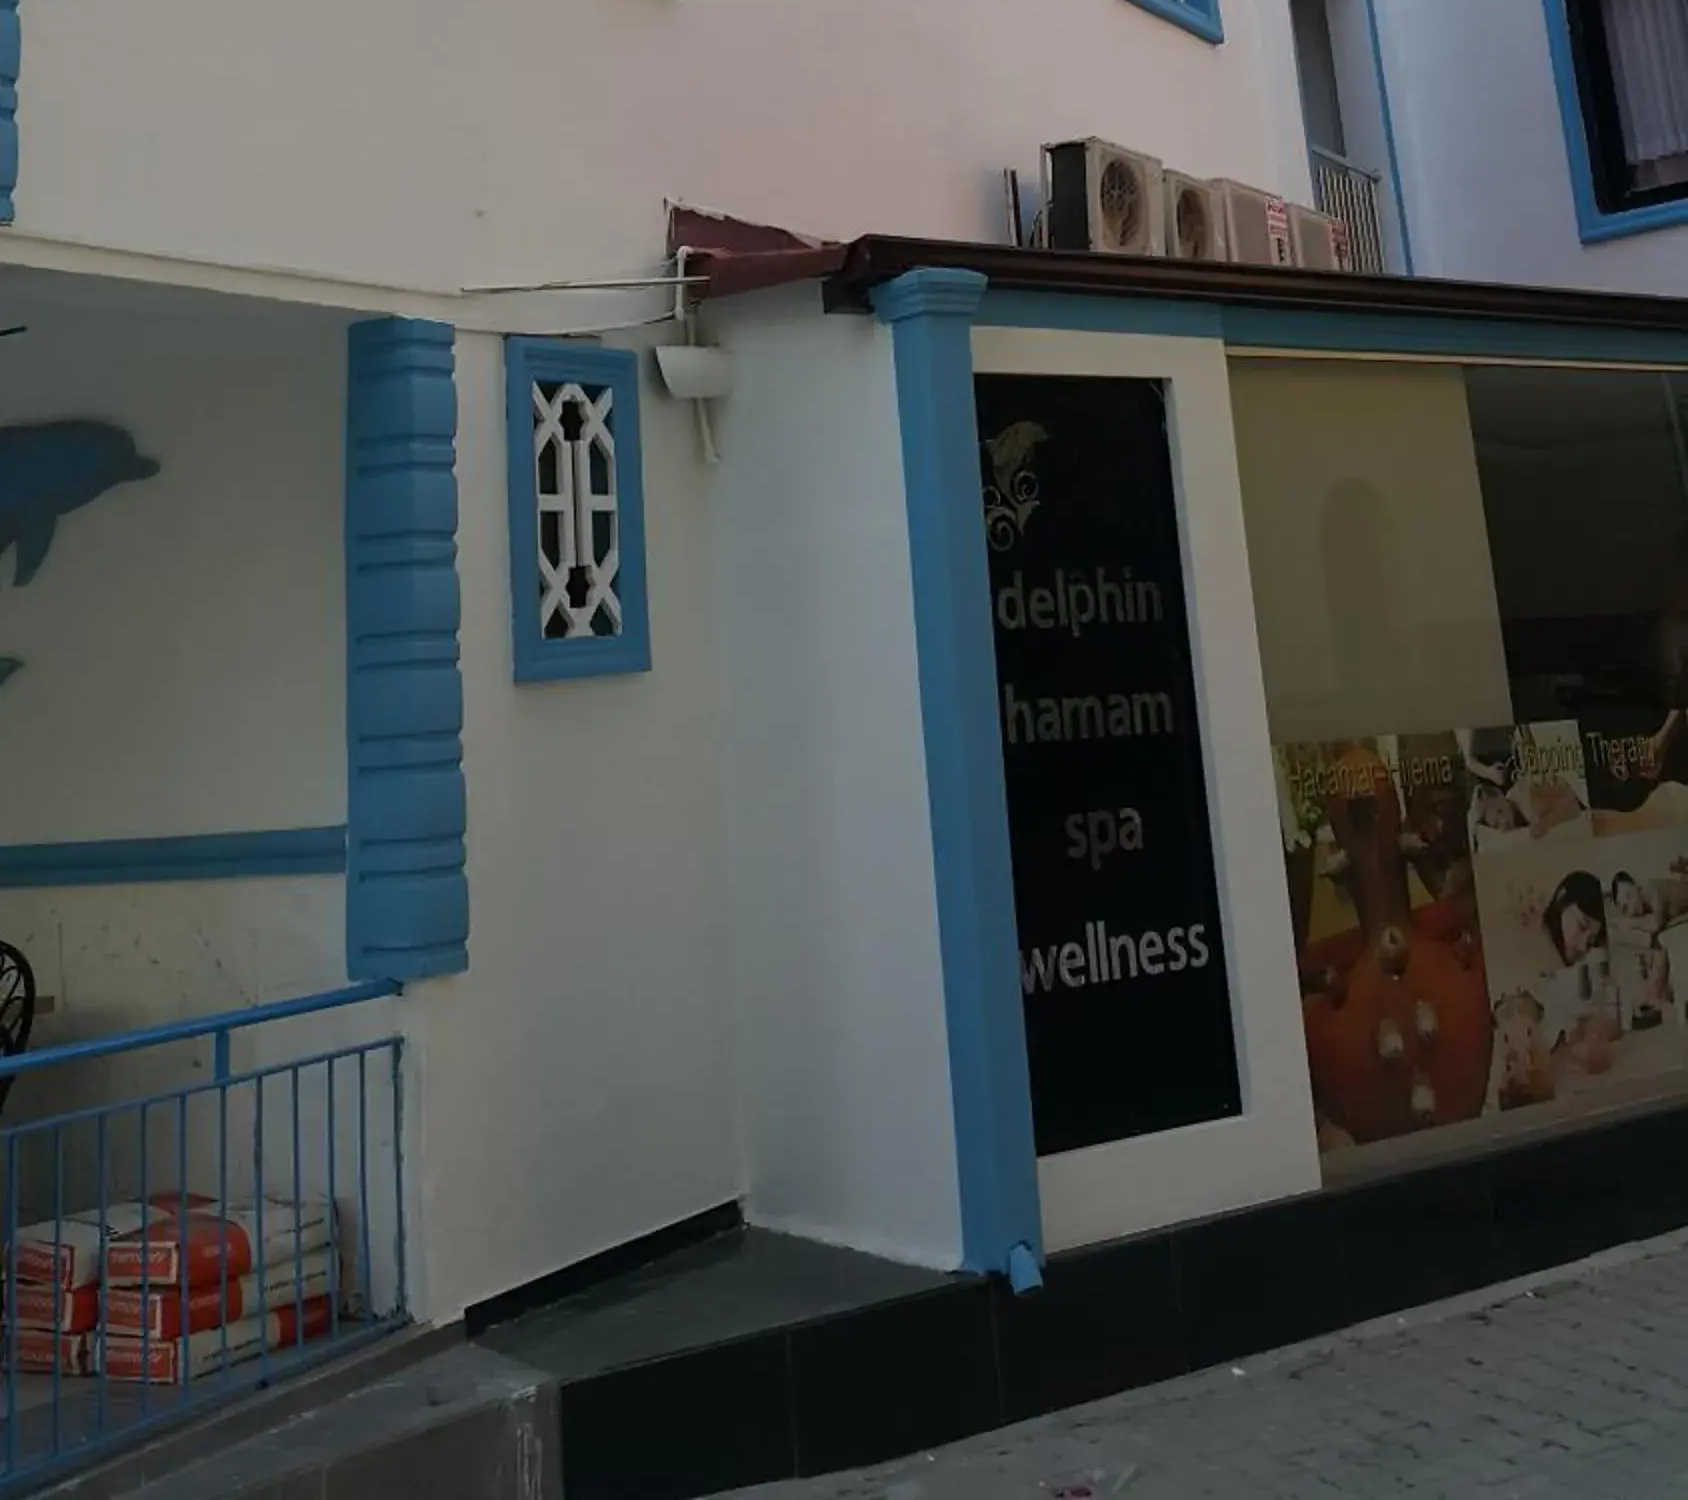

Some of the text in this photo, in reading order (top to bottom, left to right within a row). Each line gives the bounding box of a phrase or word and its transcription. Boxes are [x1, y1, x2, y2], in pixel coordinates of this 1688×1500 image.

[996, 566, 1164, 638] delphin
[1004, 684, 1175, 745] hamam
[1064, 807, 1145, 871] spa
[1019, 921, 1211, 995] wellness
